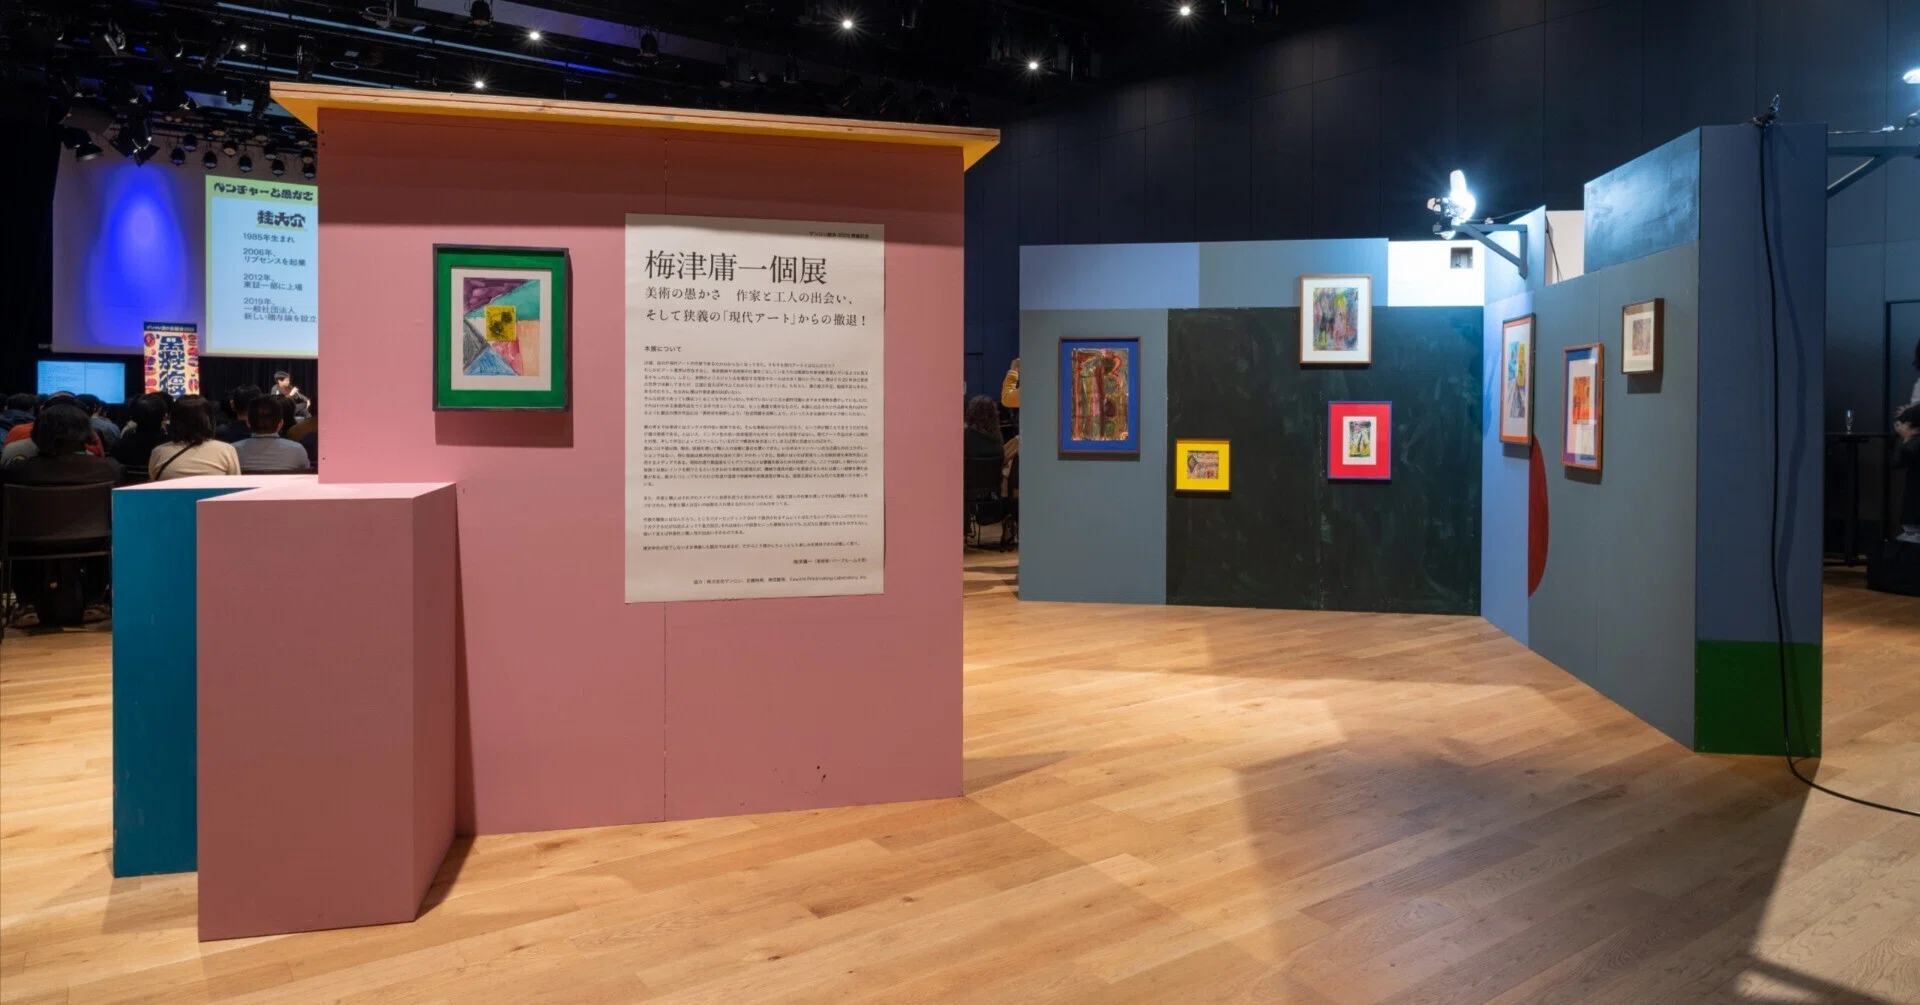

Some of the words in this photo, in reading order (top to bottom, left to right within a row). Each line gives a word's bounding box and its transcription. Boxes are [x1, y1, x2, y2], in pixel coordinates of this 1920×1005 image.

[257, 209, 306, 228] 桂大介
[243, 232, 295, 243] 1985年生まれ
[243, 247, 277, 257] 2006年、
[244, 255, 306, 266] リブセンスを起業
[644, 249, 828, 285] 梅津庸一個展
[243, 273, 275, 282] 2012年、
[243, 281, 303, 292] 東証一部に上場
[645, 286, 721, 302] 美術の愚かさ
[736, 289, 854, 305] 作家と工人の出会い、
[243, 297, 275, 306] 2019年、
[243, 305, 296, 314] 一般社団法人
[243, 312, 317, 323] 新しい贈与論を設立
[645, 309, 867, 326] そして狭義の「現代アート」からの撤退！
[644, 345, 682, 353] 本展について
